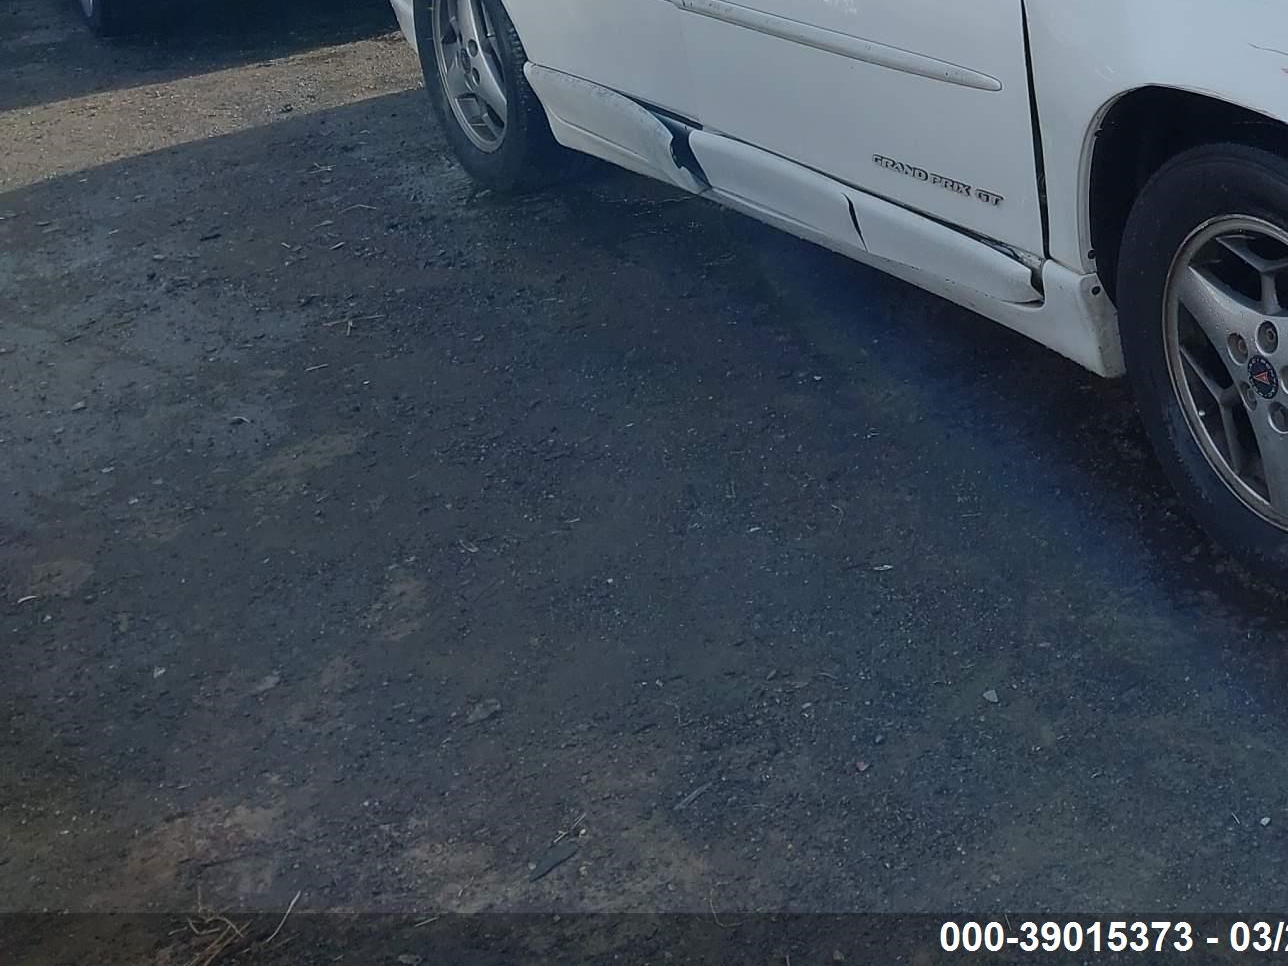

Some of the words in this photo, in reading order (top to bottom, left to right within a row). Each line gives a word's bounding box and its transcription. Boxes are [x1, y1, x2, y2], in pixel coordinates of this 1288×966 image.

[872, 153, 929, 182] GRAND
[930, 172, 972, 197] PRIX
[975, 188, 1004, 206] GT
